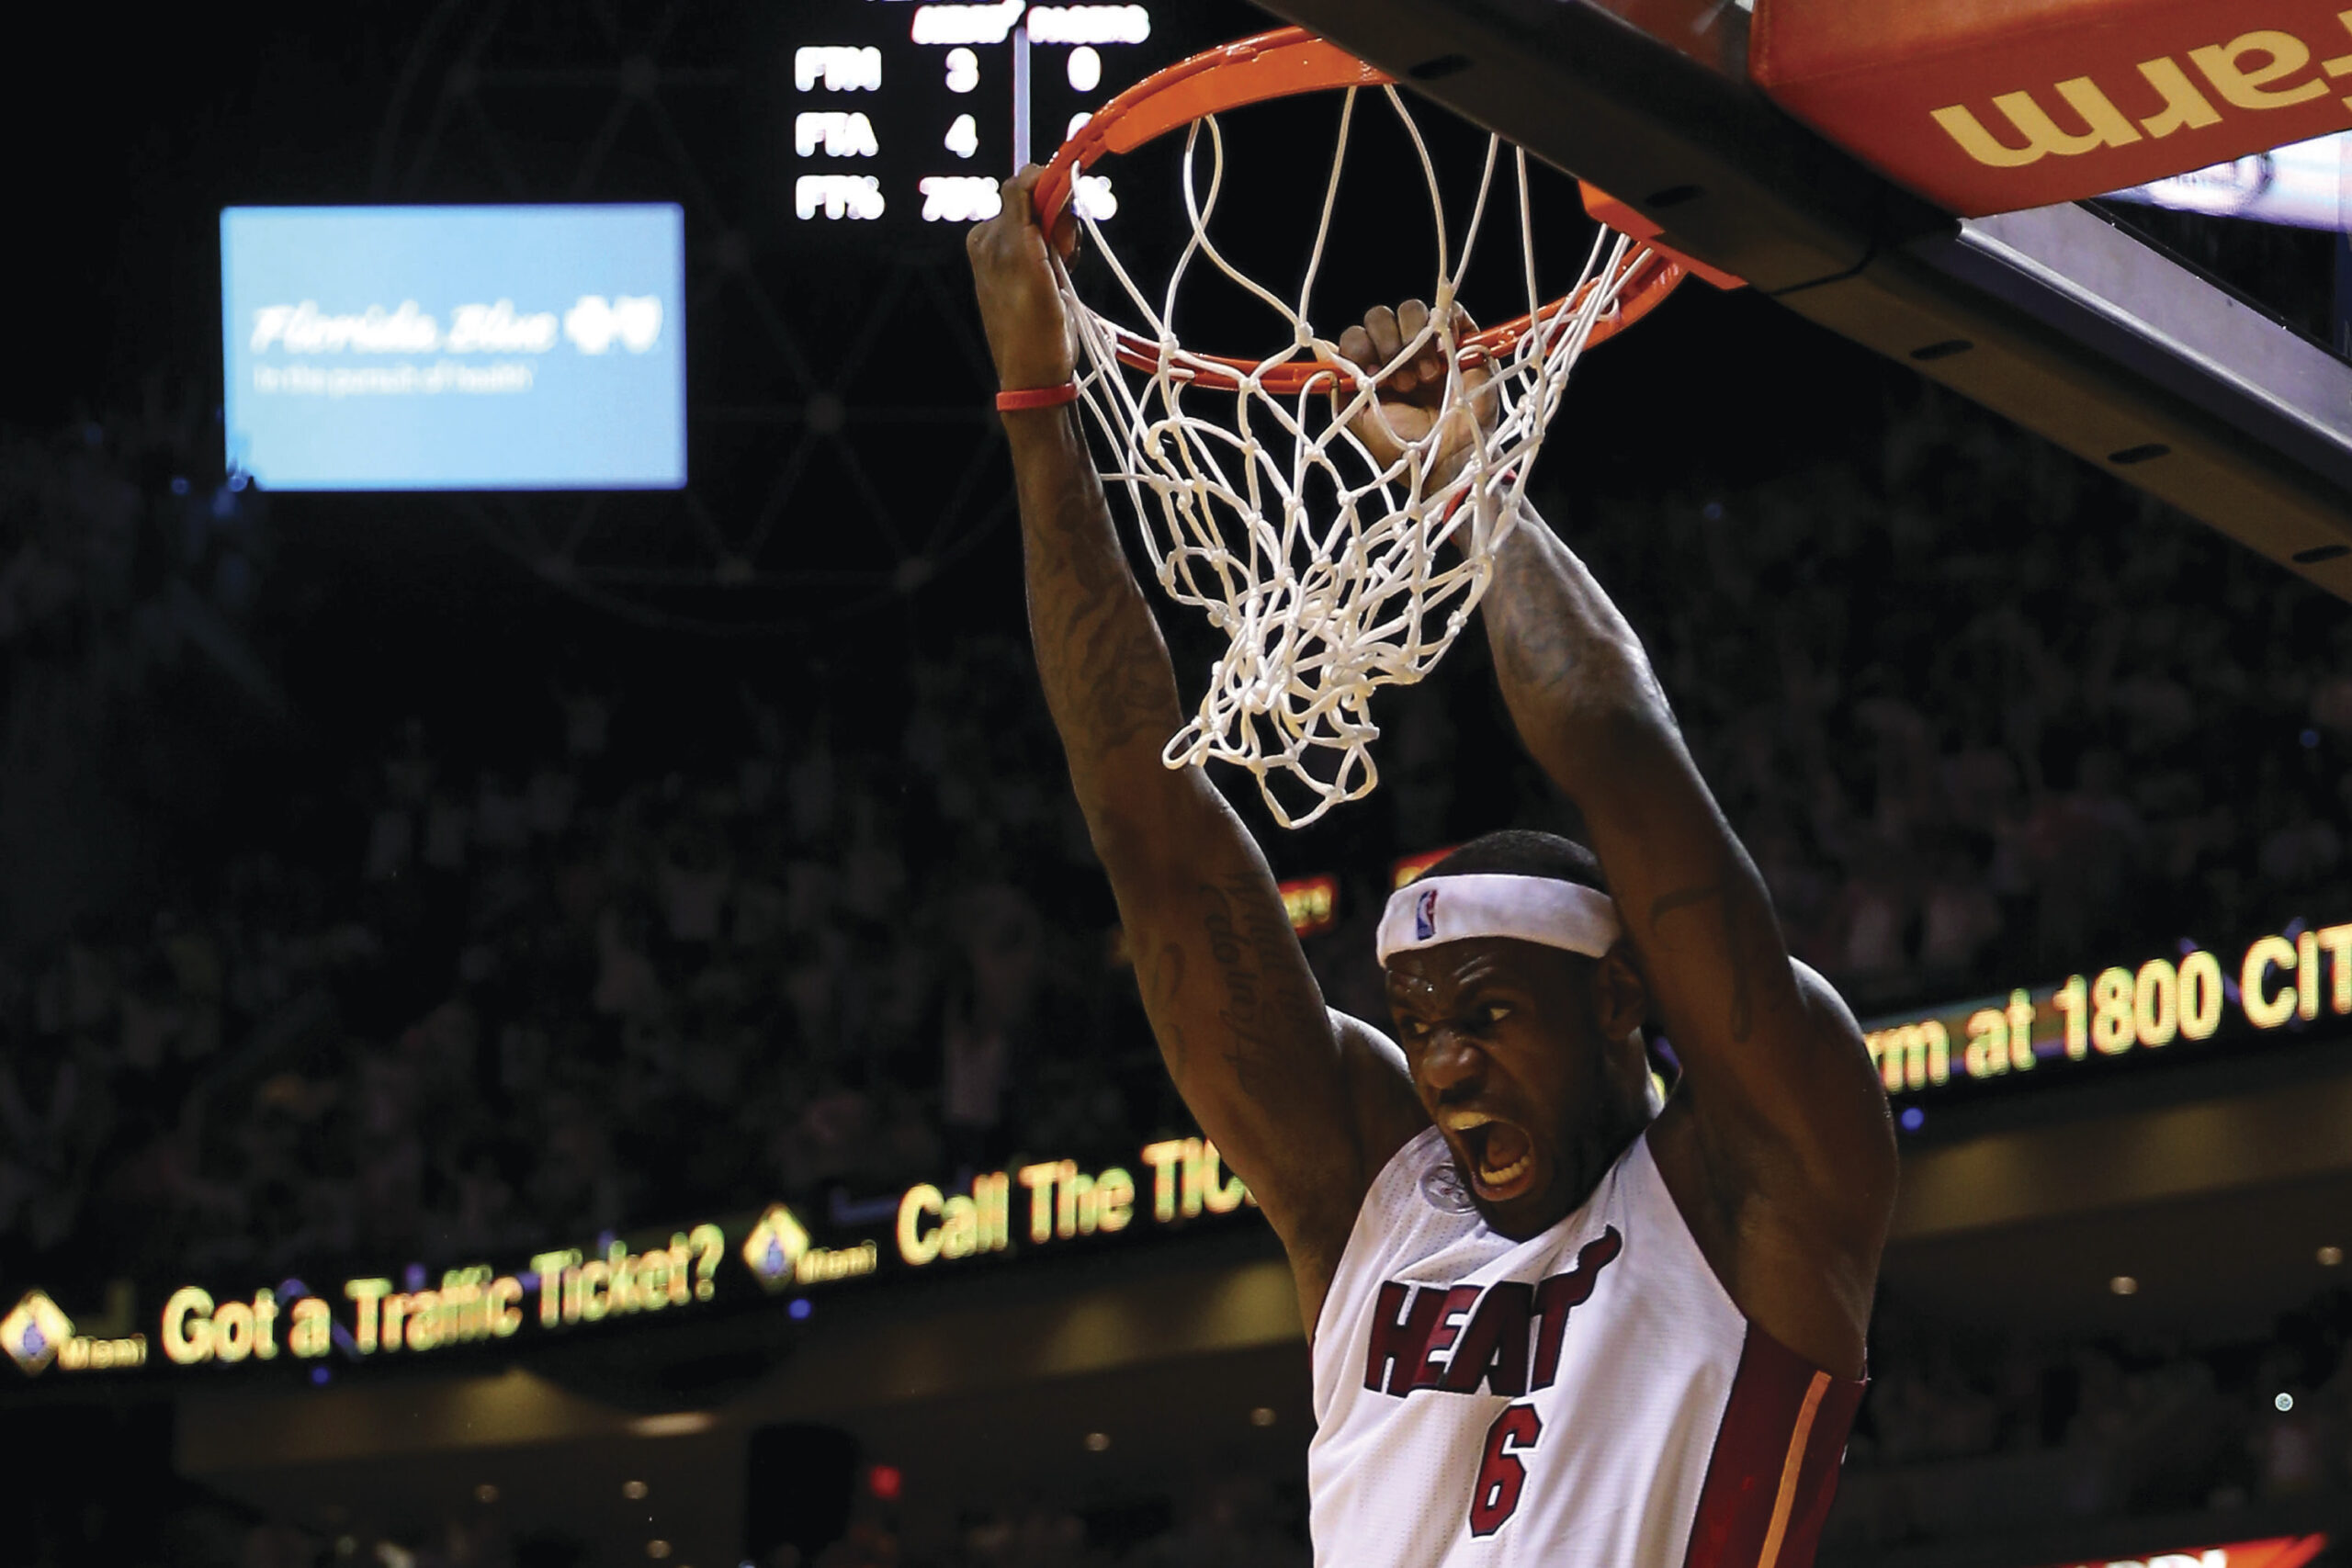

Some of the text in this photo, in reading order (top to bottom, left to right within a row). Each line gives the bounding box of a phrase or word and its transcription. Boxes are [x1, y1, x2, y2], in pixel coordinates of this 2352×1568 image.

[944, 113, 978, 158] 4
[945, 47, 979, 93] 3
[898, 1170, 1011, 1266] Call
[1018, 1157, 1135, 1244] The
[1141, 1135, 1260, 1223] Tic
[1964, 987, 2037, 1078] at
[2052, 949, 2223, 1062] 1800
[2240, 922, 2352, 1030] CIT
[162, 1223, 726, 1364] Got a Traffic Ticket?
[1364, 1224, 1623, 1397] HEAT
[1470, 1406, 1543, 1538] 6
